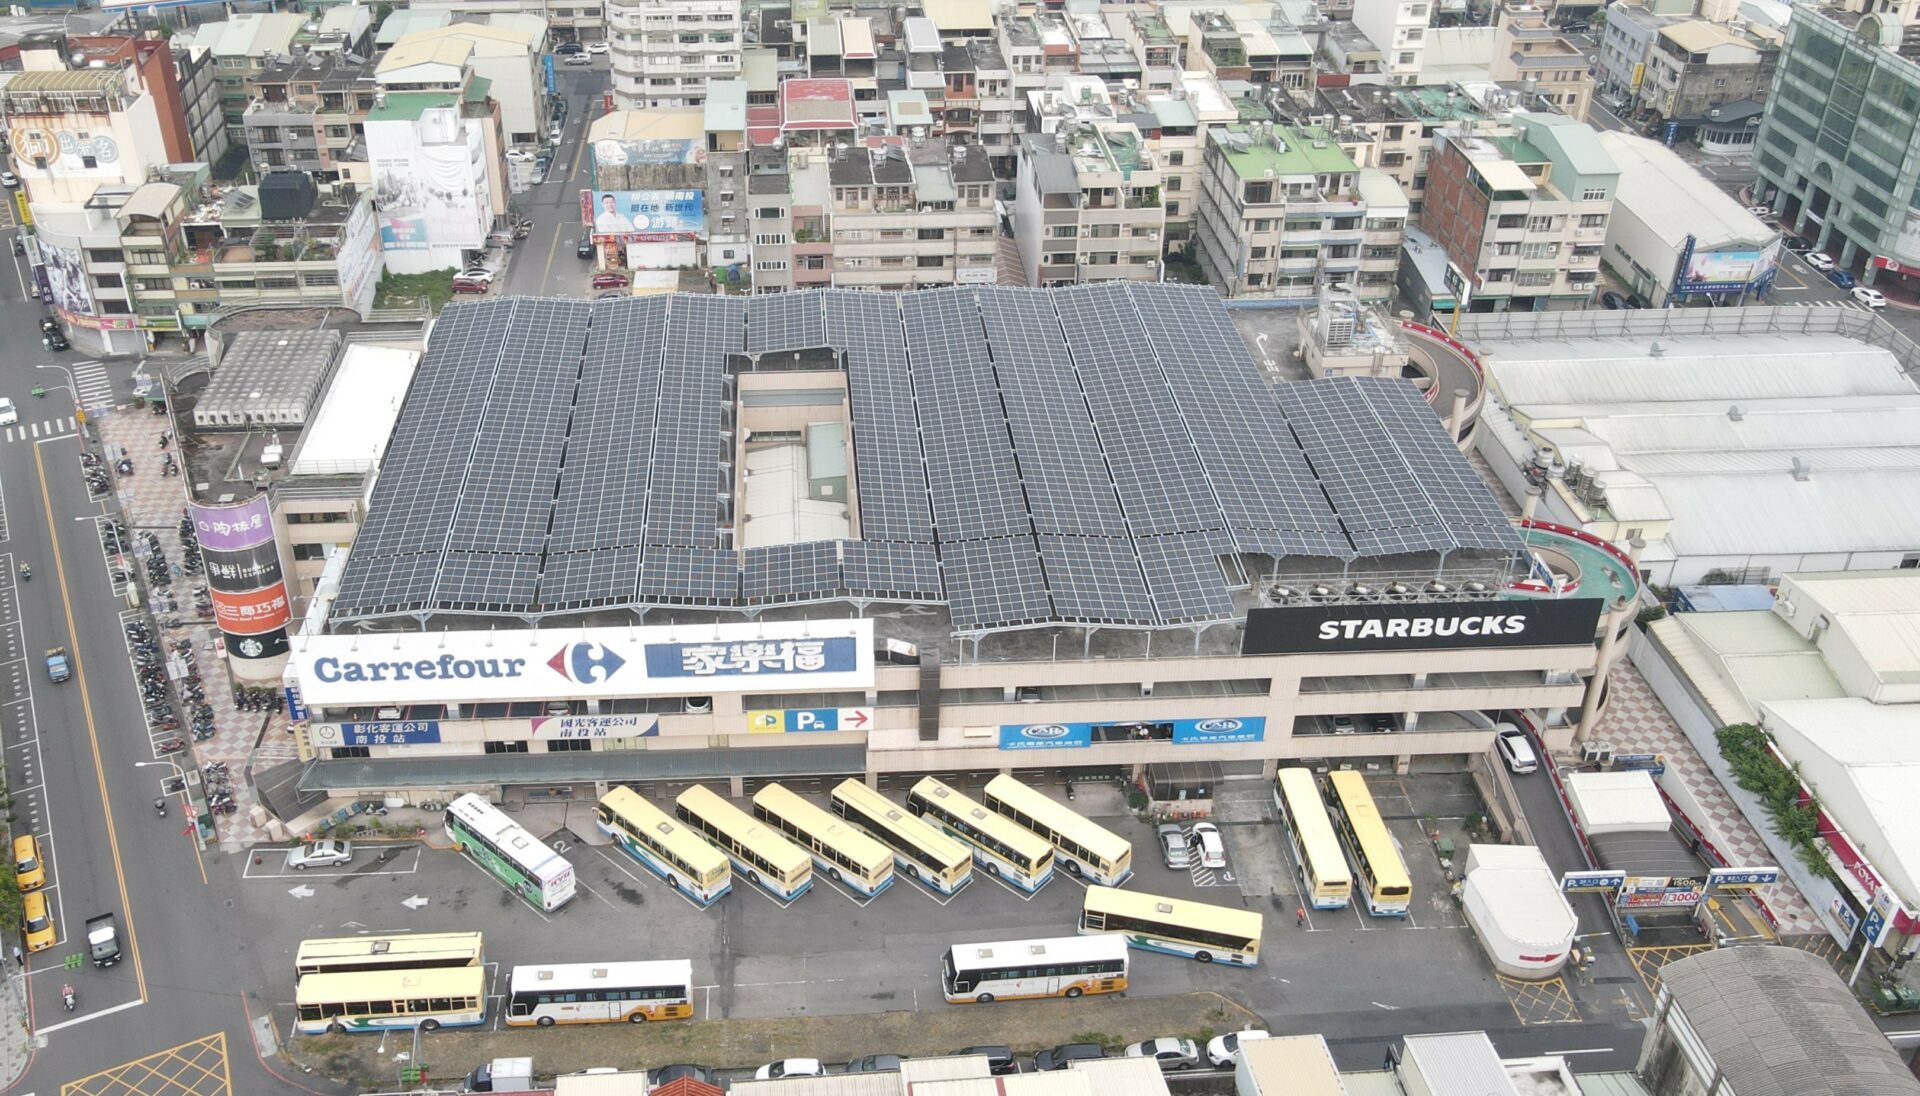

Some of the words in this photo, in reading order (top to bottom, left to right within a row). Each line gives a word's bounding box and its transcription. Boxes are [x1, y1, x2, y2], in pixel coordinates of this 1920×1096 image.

[1318, 615, 1526, 640] STARBUCKS
[682, 641, 826, 675] 家樂福
[314, 654, 525, 683] Carrefour
[560, 717, 638, 728] 國光客運公司
[797, 711, 815, 730] P
[354, 722, 428, 734] 彰化客運公司
[560, 729, 607, 738] 南投站
[355, 734, 406, 745] 南投站
[553, 840, 572, 854] 2
[1671, 892, 1700, 902] 3000
